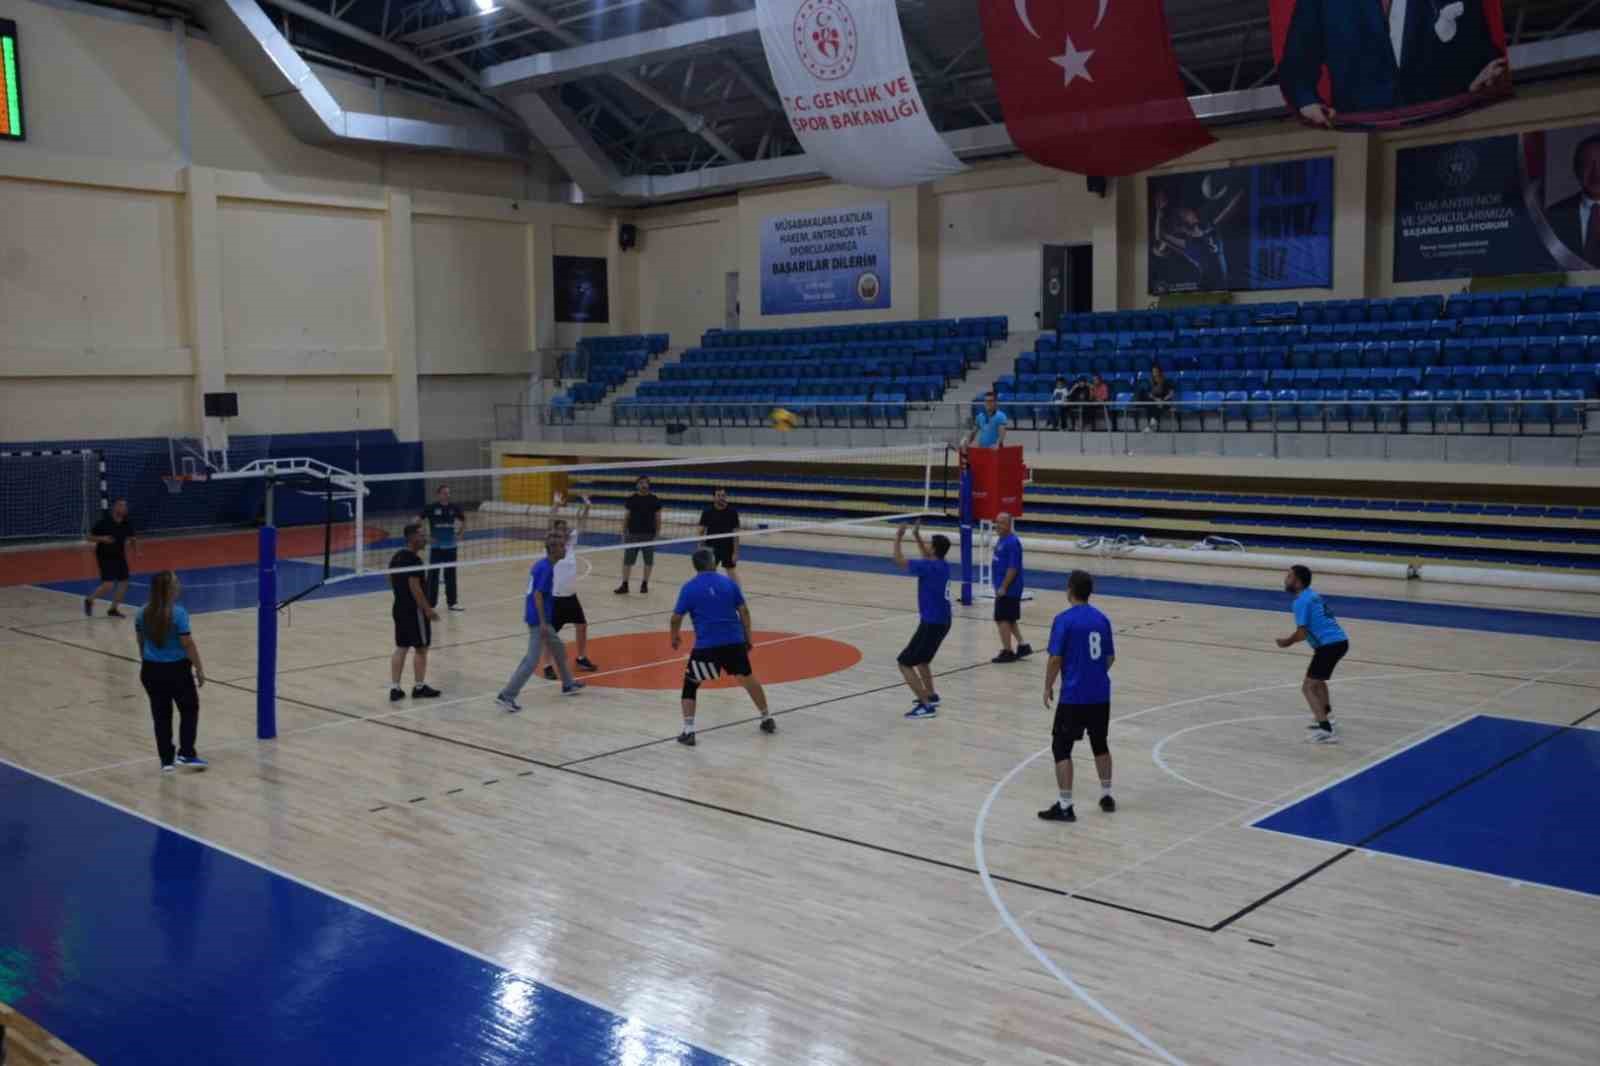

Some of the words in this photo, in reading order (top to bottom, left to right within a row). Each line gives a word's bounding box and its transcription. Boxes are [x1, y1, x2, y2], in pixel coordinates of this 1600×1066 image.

[813, 85, 881, 109] GENÇLİK
[884, 76, 911, 97] VE
[791, 115, 829, 132] SPOR
[831, 98, 919, 130] BAKANLIĞI
[772, 257, 830, 275] BAŞARILAR
[831, 252, 877, 270] DİLERİM
[1088, 631, 1102, 660] 8
